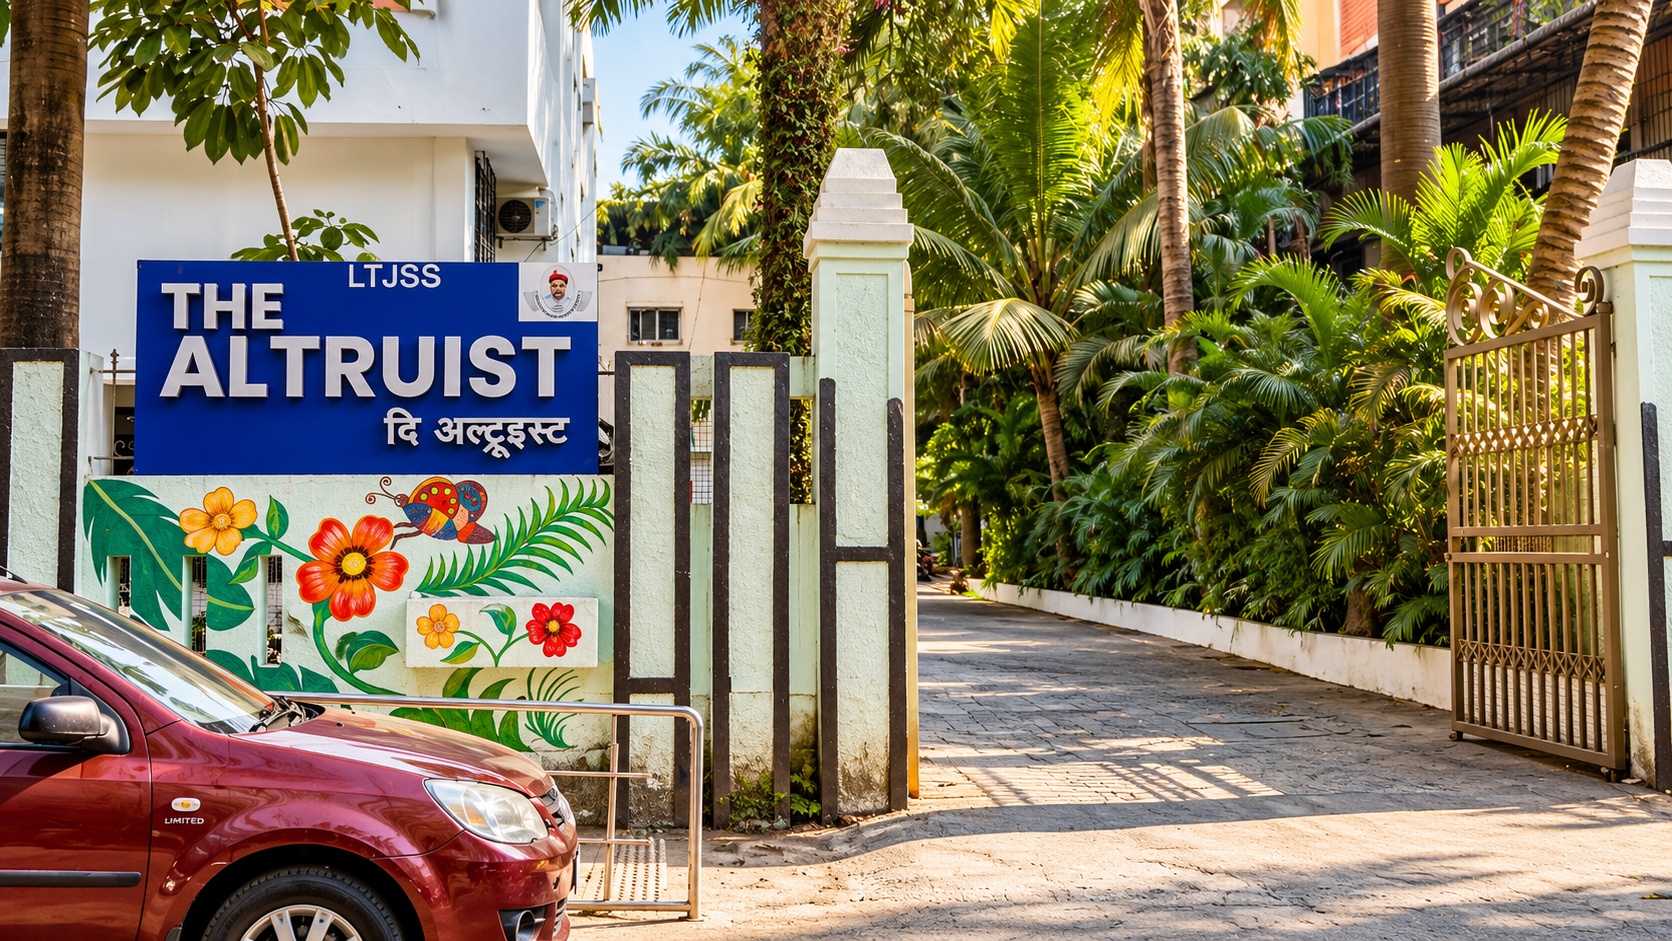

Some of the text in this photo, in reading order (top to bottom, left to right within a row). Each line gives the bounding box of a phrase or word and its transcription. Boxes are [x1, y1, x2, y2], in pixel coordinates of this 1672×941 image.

[348, 263, 442, 289] LTJSS
[161, 282, 284, 330] THE
[159, 334, 572, 399] ALTRUIST
[383, 406, 571, 459] दि अल्ट्रूइस्ट
[164, 817, 205, 825] LIMITED
